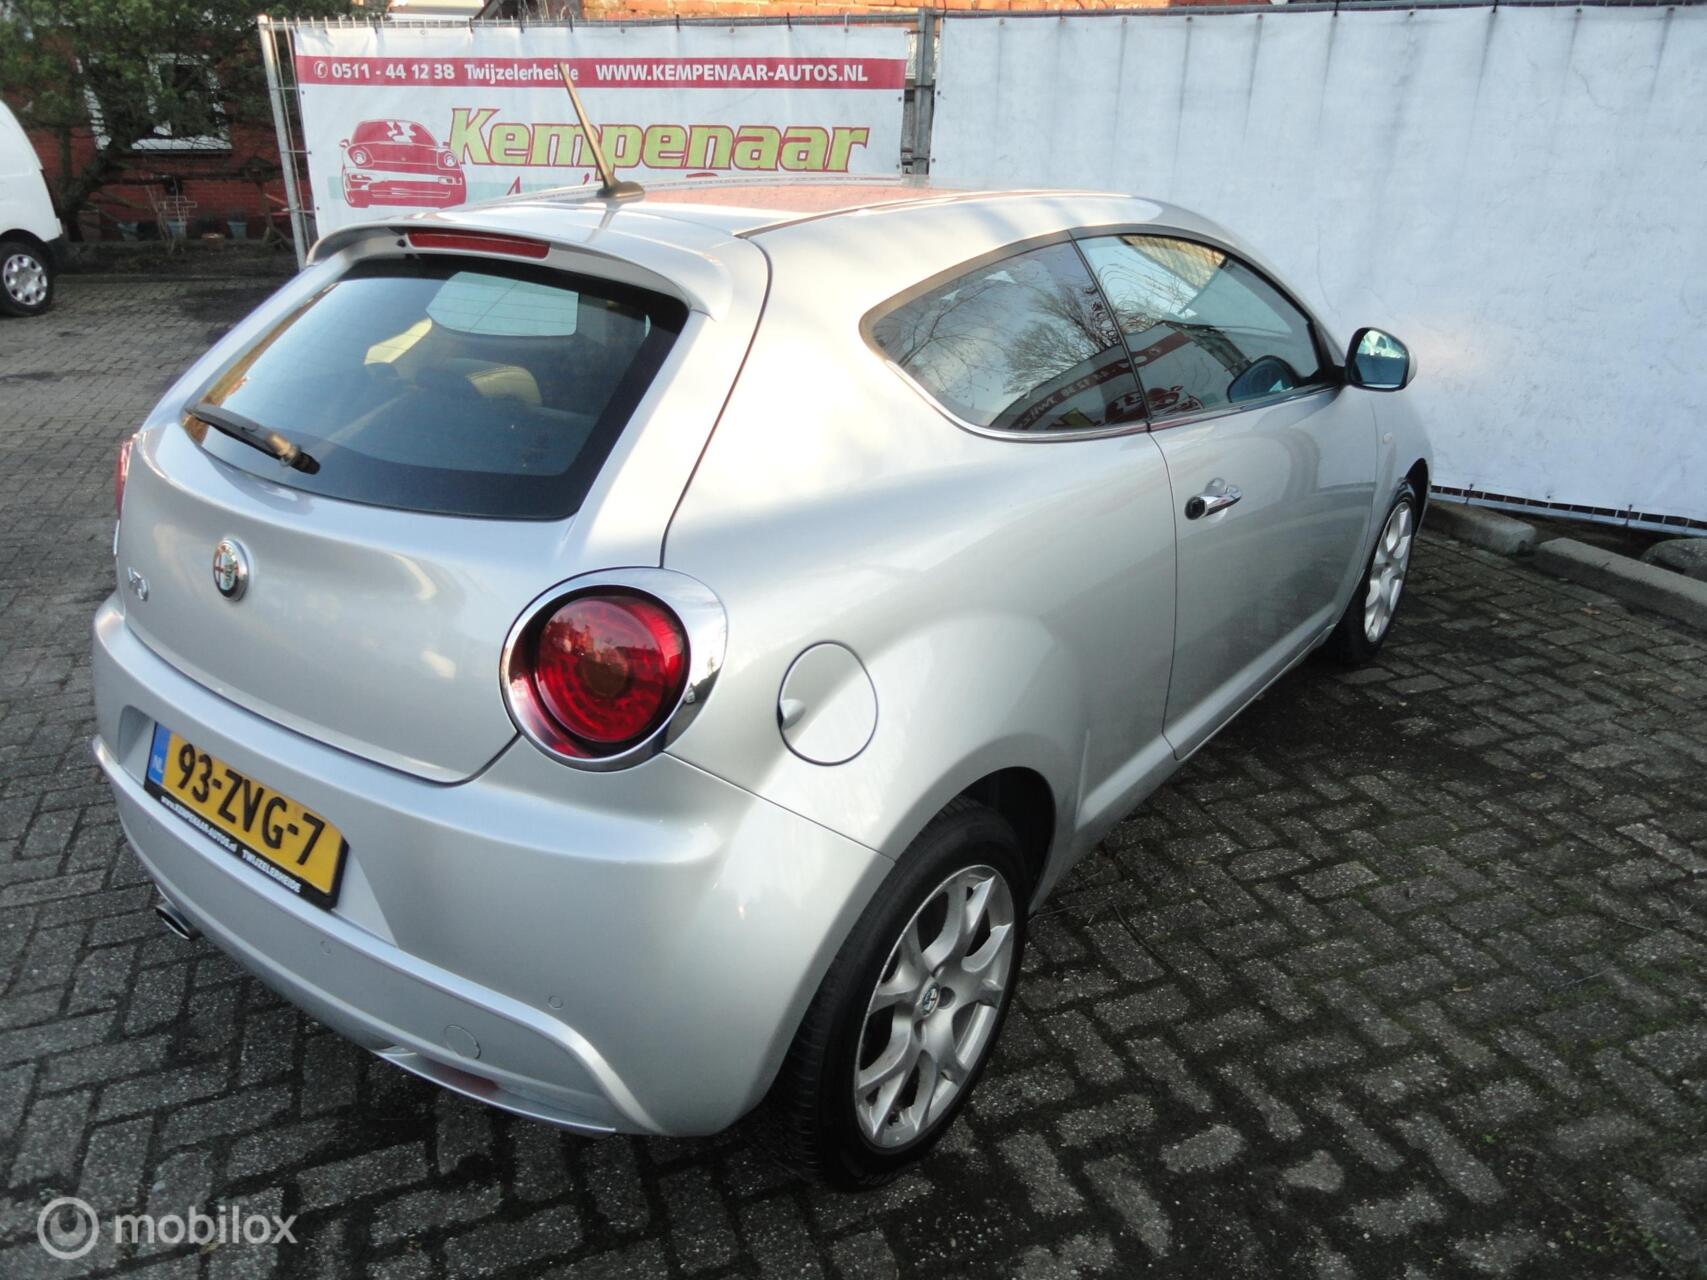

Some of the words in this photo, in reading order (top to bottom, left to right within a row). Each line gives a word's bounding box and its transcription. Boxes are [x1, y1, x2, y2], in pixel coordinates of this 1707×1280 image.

[331, 63, 370, 79] 0511
[385, 63, 406, 79] 44
[412, 64, 429, 79] 12
[434, 64, 455, 79] 38
[595, 64, 868, 82] WWW.KEMPENAAR-AUTOS.NL
[450, 107, 870, 181] Kempenaar
[178, 743, 326, 866] 93-ZVG-7
